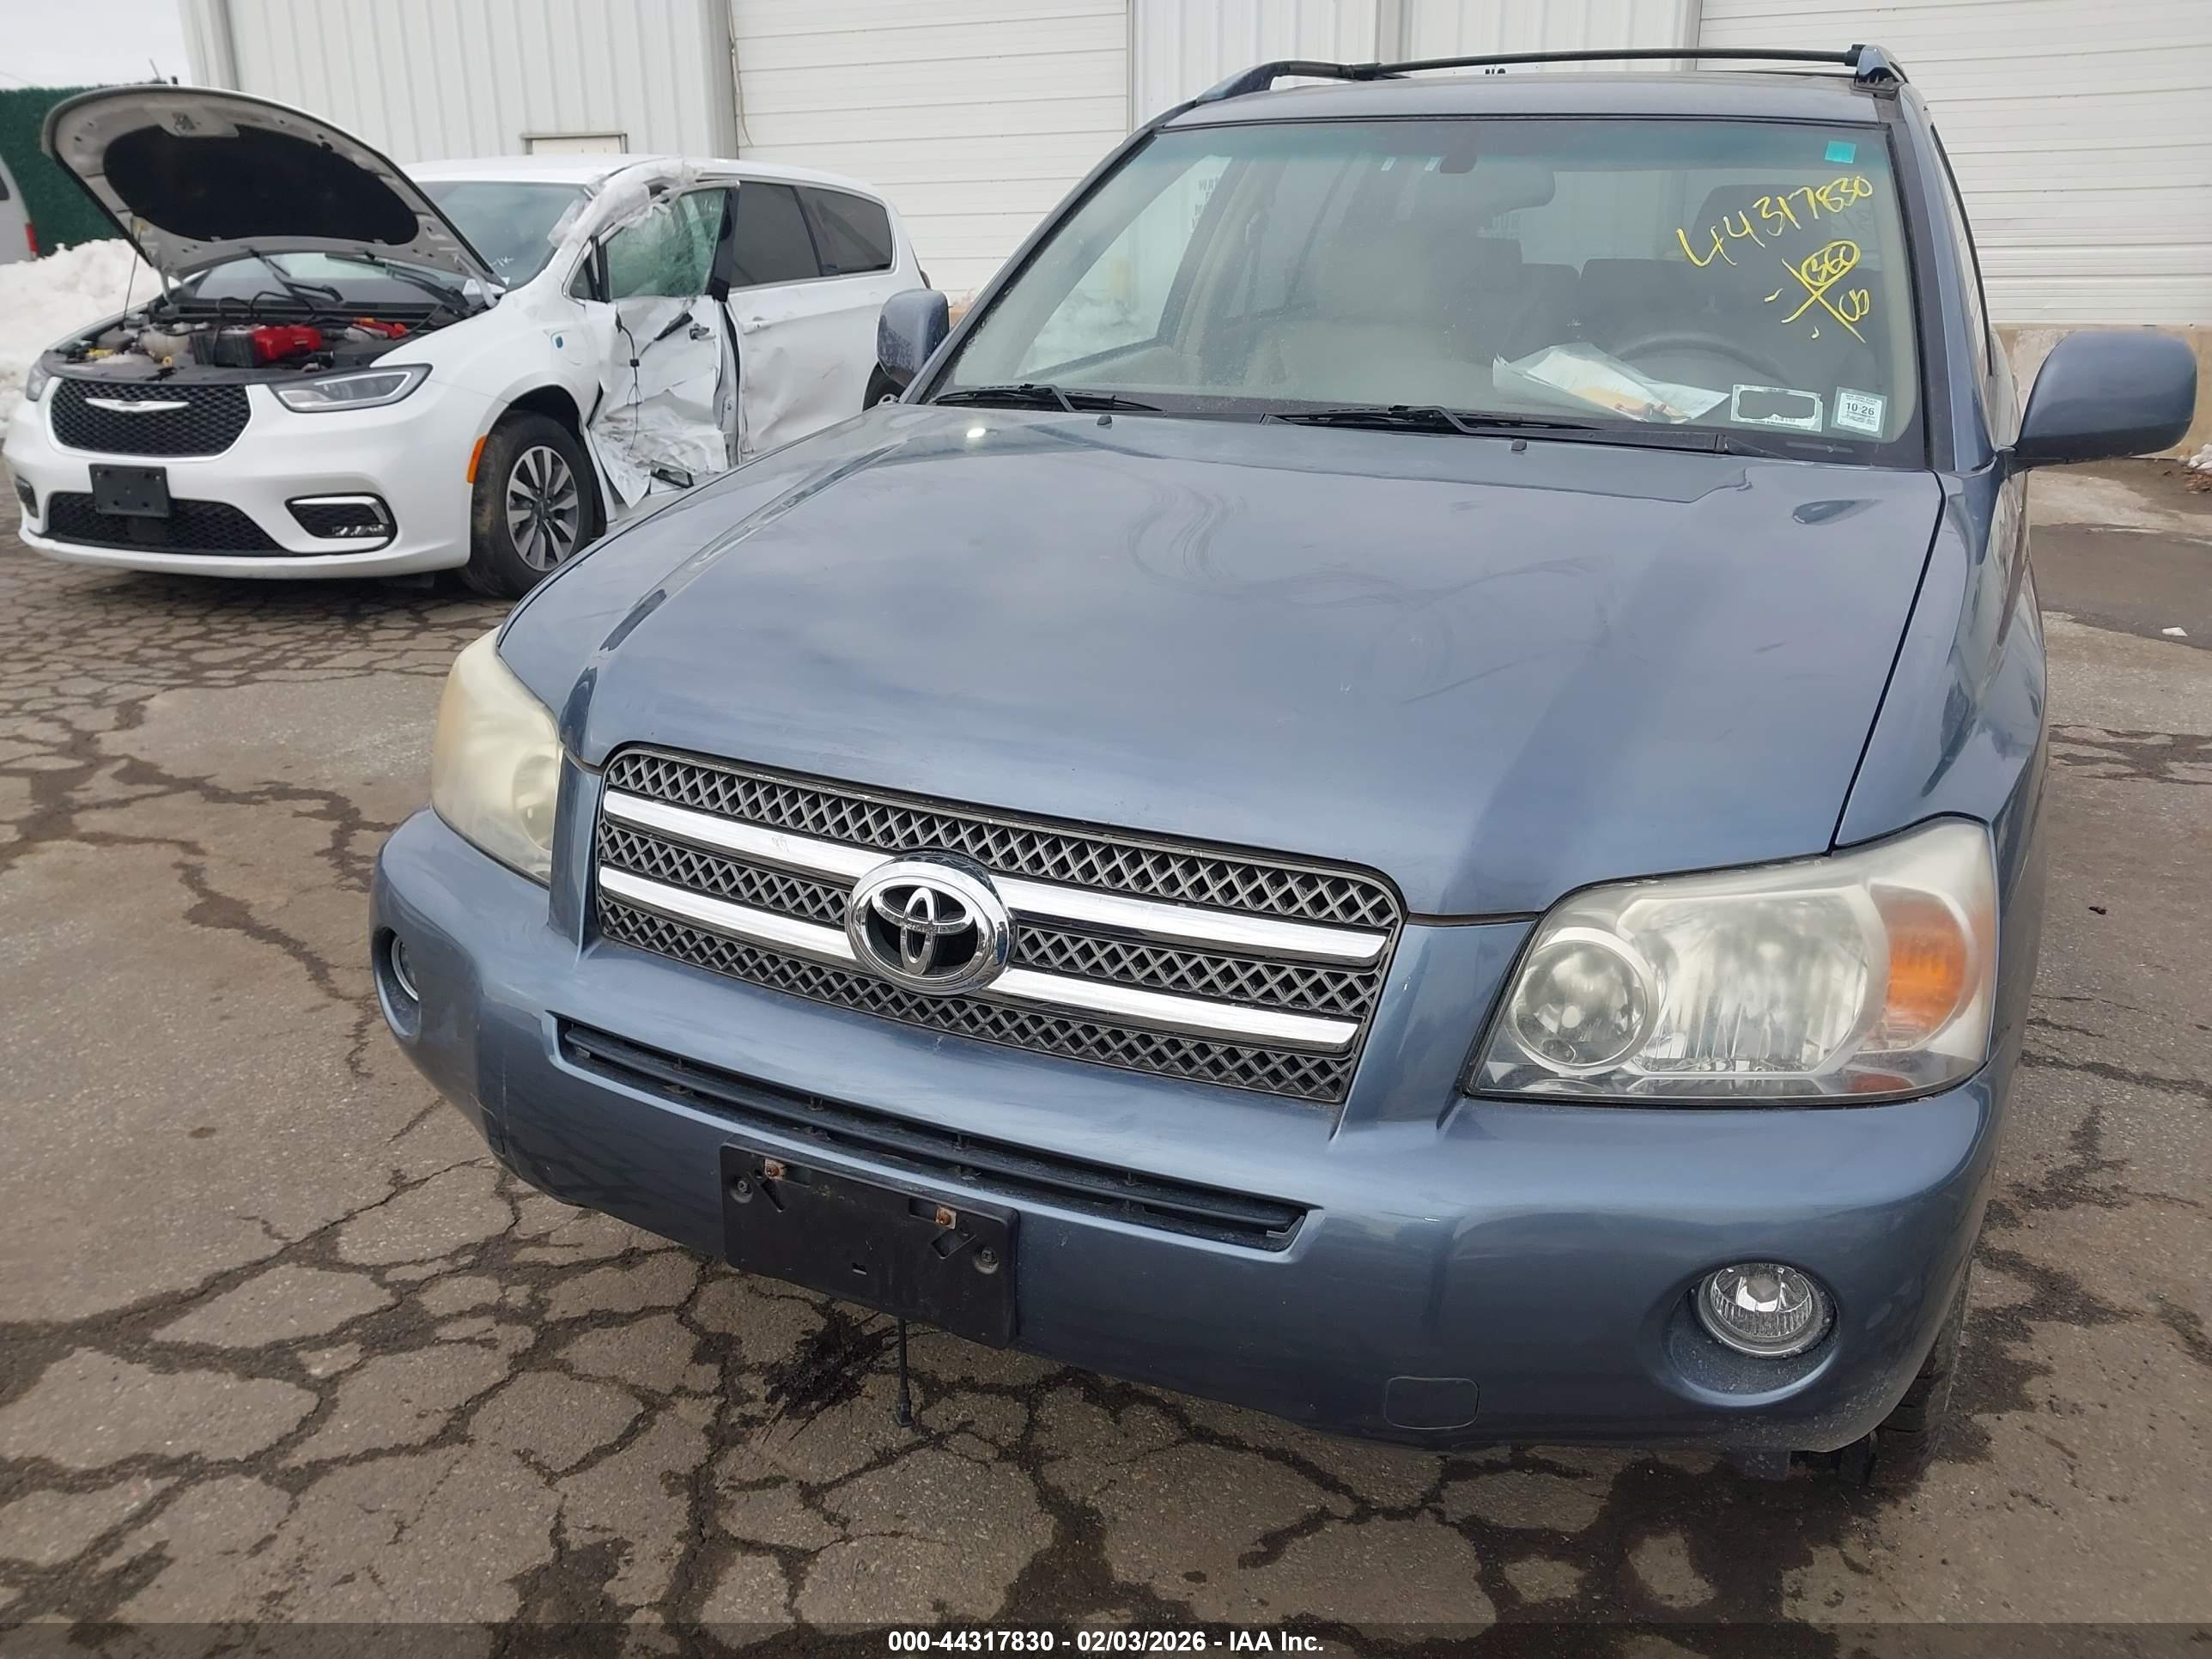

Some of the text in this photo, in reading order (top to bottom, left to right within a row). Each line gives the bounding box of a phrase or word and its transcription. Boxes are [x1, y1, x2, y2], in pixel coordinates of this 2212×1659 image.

[1676, 175, 1873, 267] 44317830
[1845, 402, 1875, 416] 10 26
